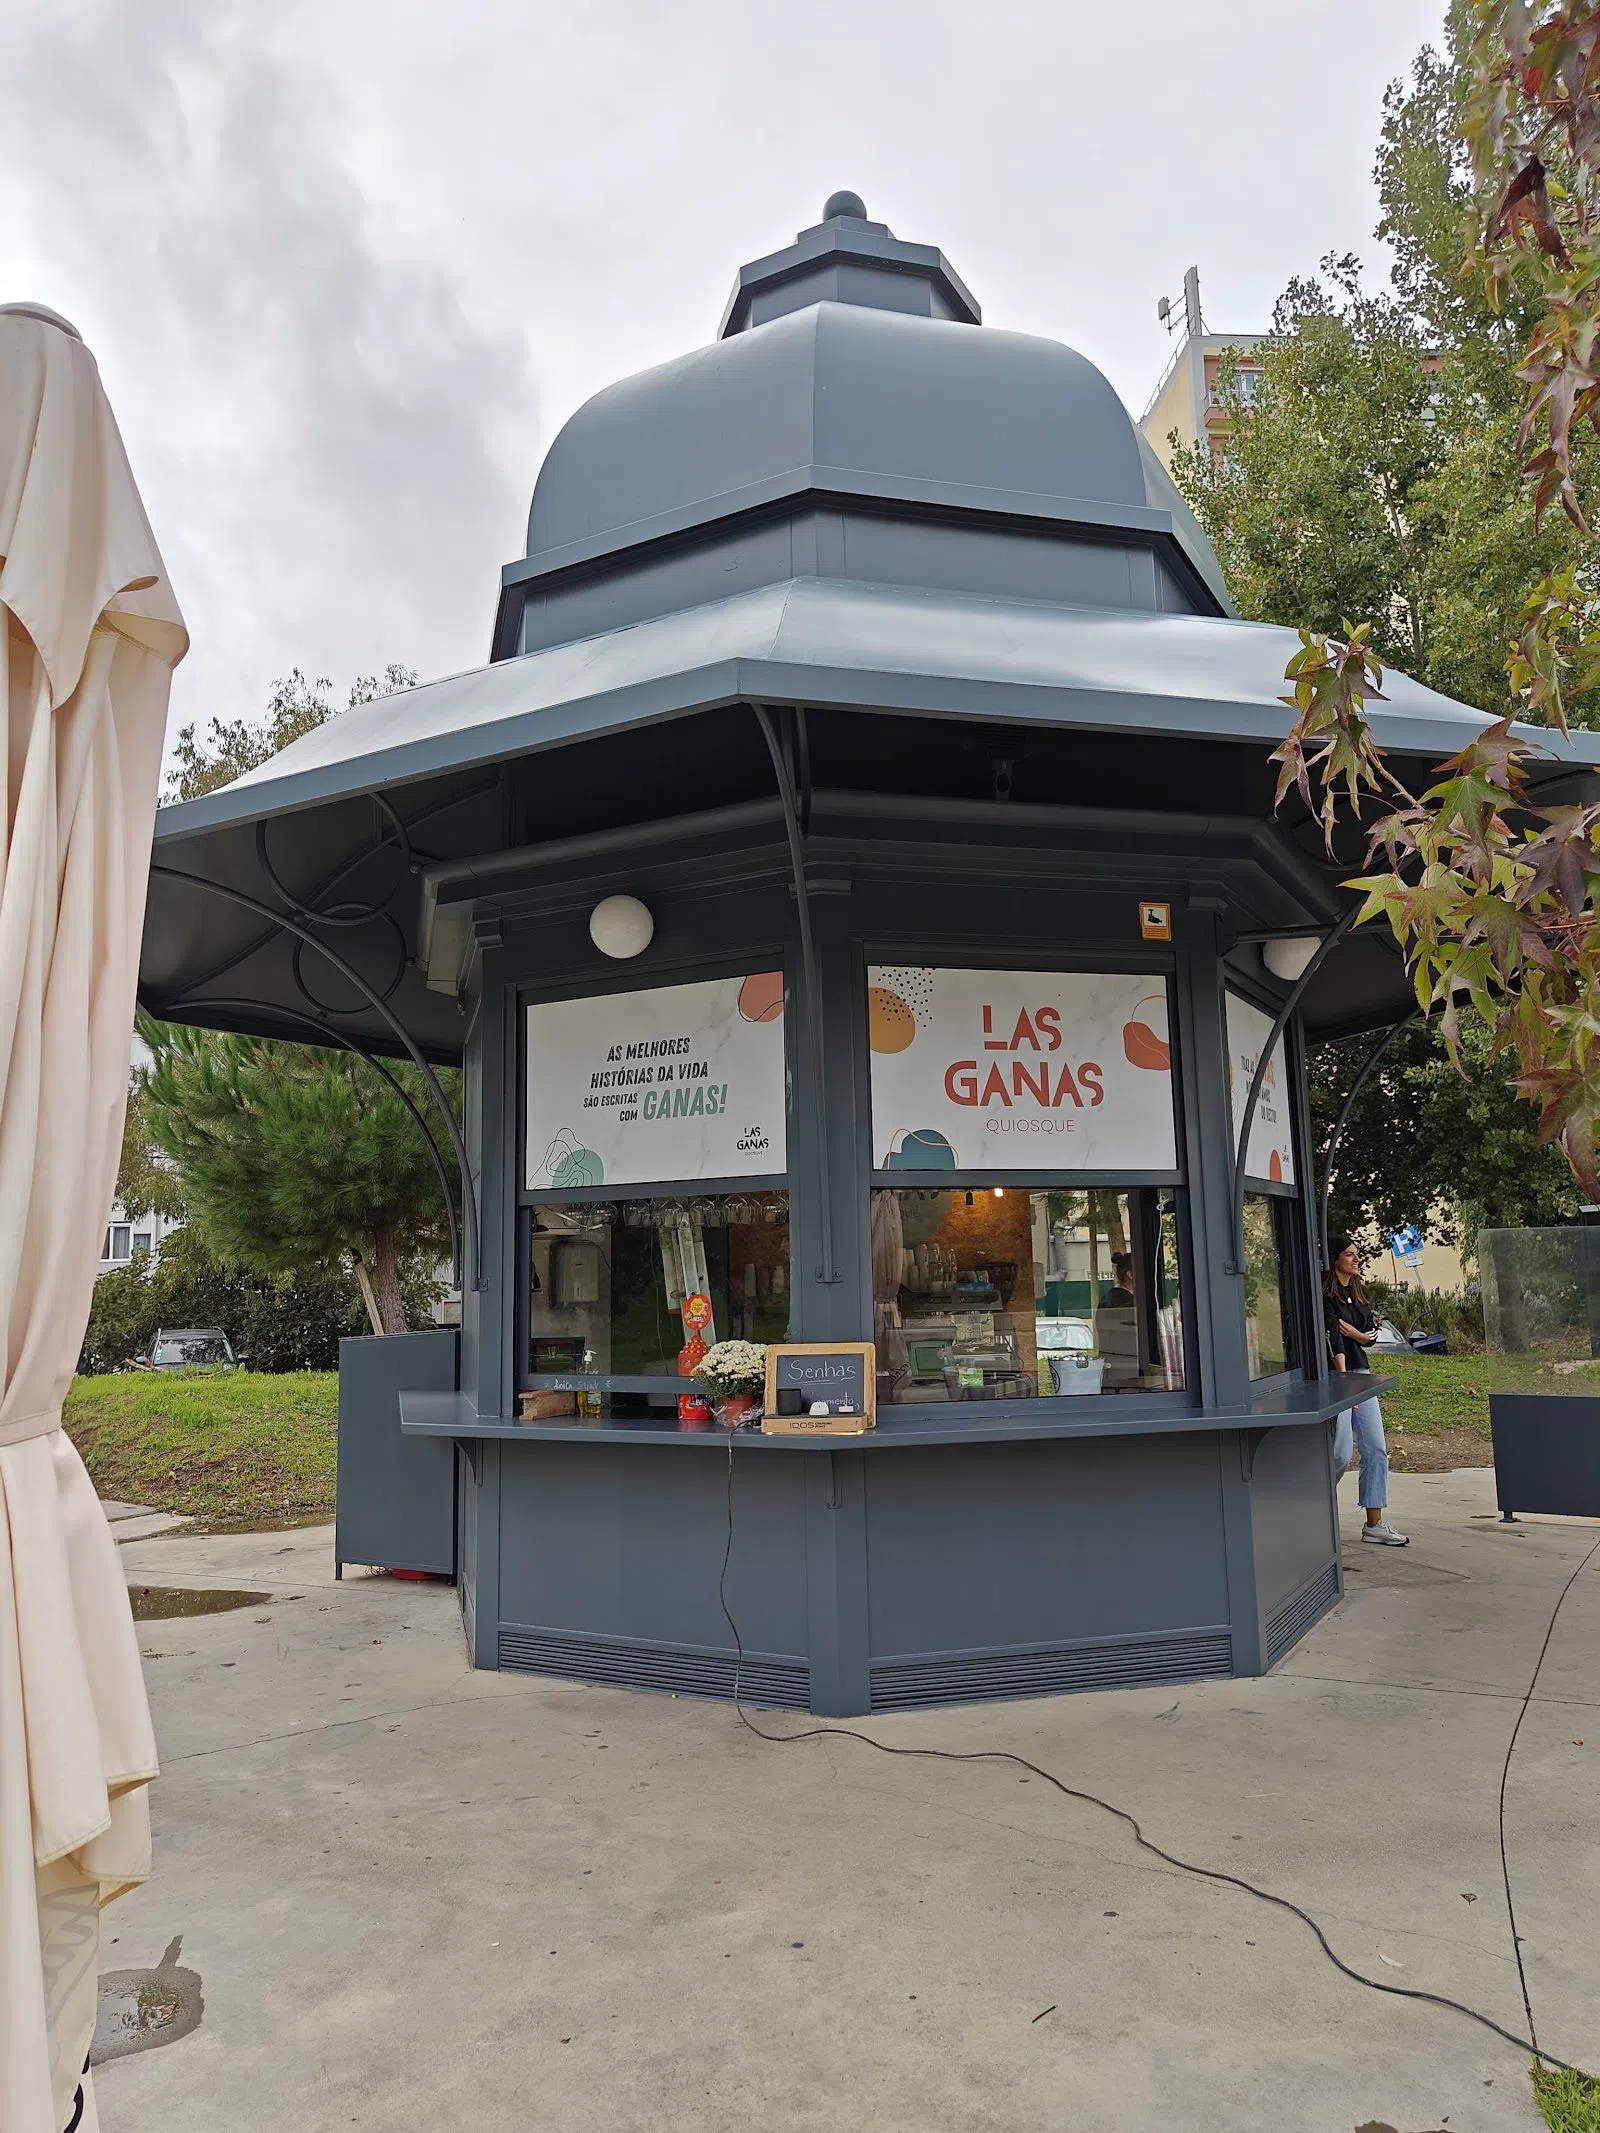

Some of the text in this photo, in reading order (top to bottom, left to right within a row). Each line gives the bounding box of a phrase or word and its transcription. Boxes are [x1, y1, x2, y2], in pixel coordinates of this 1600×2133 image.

[982, 1004, 1062, 1051] LAS
[606, 1037, 690, 1062] AS MELHORES
[590, 1061, 708, 1089] HISTÓRIAS DA VIDA
[944, 1060, 1104, 1107] GANAS
[582, 1092, 638, 1109] SÃO ESCRITAS
[619, 1084, 728, 1121] COM GANAS!
[744, 1126, 761, 1137] LAS
[986, 1118, 1075, 1134] QUIOSQUE
[736, 1138, 769, 1150] GANAS
[788, 1360, 856, 1381] Senhas
[790, 1422, 815, 1430] IQOS
